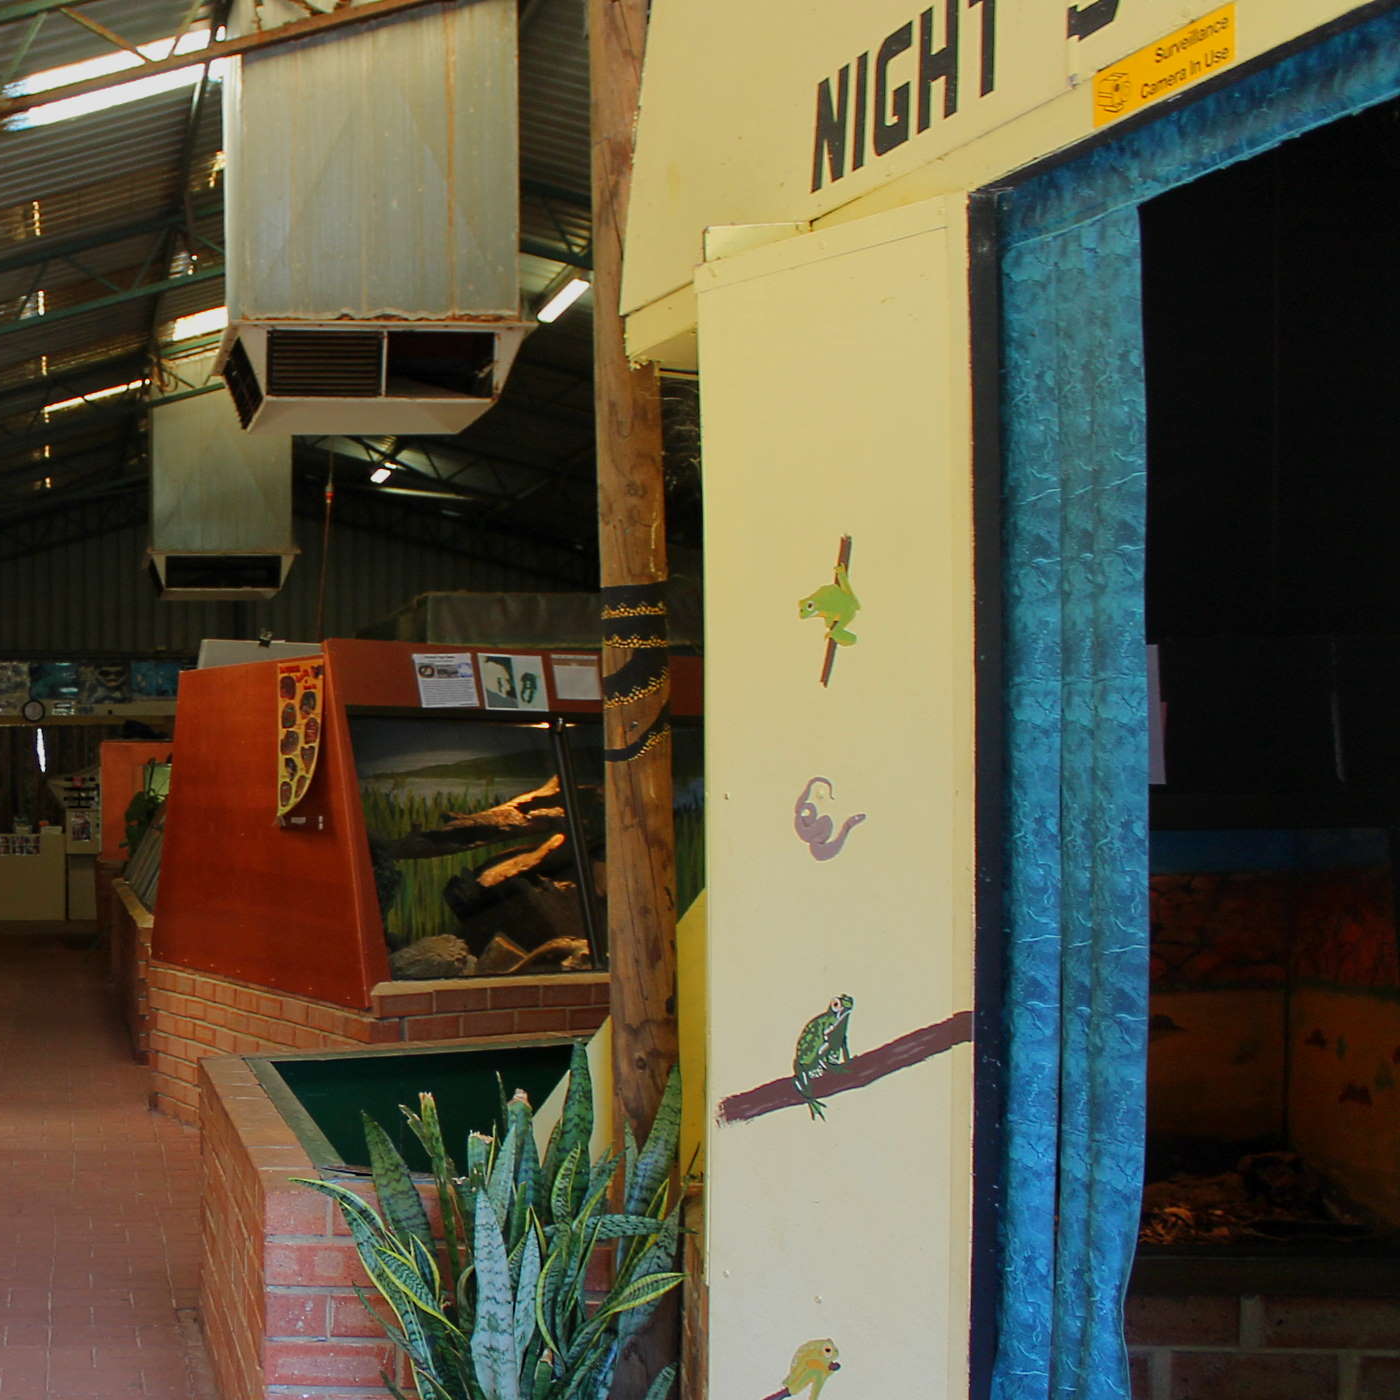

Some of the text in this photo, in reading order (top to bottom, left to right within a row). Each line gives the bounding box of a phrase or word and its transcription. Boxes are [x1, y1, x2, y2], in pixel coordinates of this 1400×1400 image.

[1154, 16, 1229, 64] Surveillance
[810, 0, 995, 193] NIGHT
[1140, 47, 1230, 99] Camera In Use
